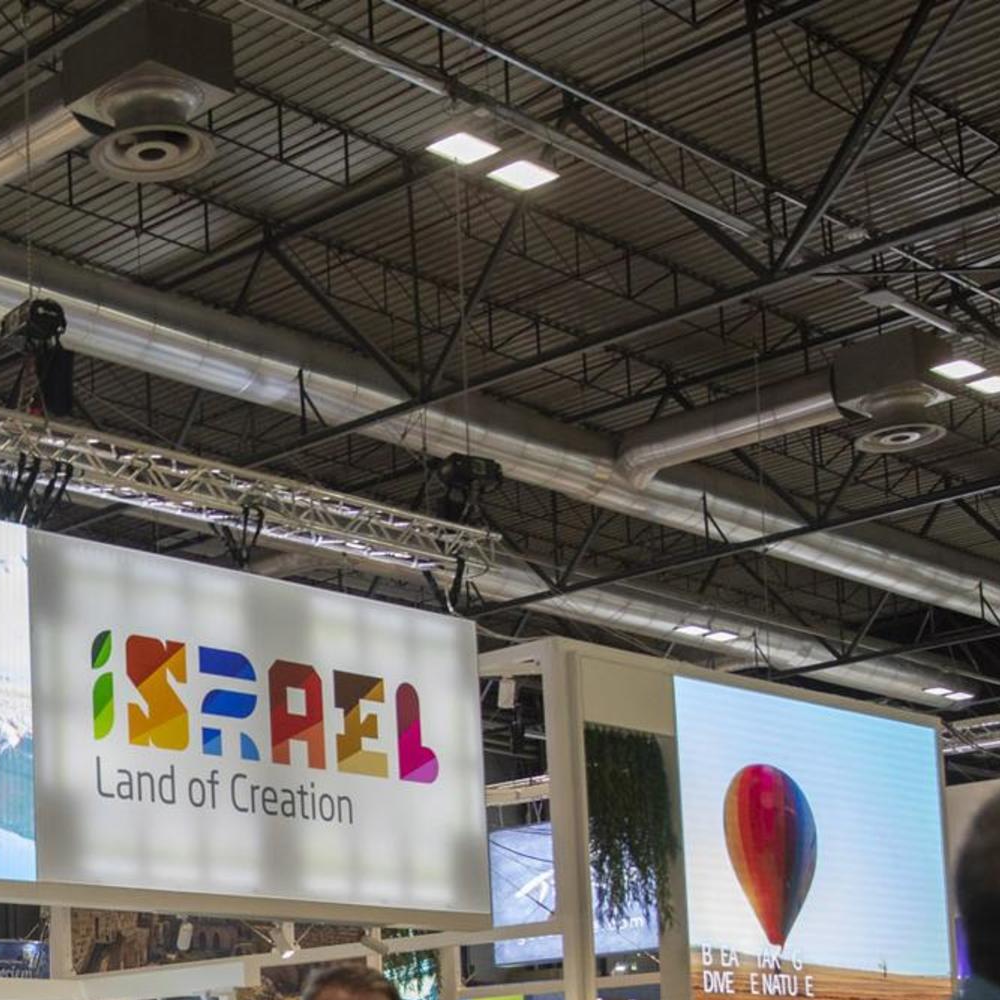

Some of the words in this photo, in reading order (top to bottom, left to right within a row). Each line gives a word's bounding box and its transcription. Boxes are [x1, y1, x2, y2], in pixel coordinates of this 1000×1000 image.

[96, 755, 176, 805] Land
[188, 769, 220, 809] of
[230, 773, 354, 824] Creation
